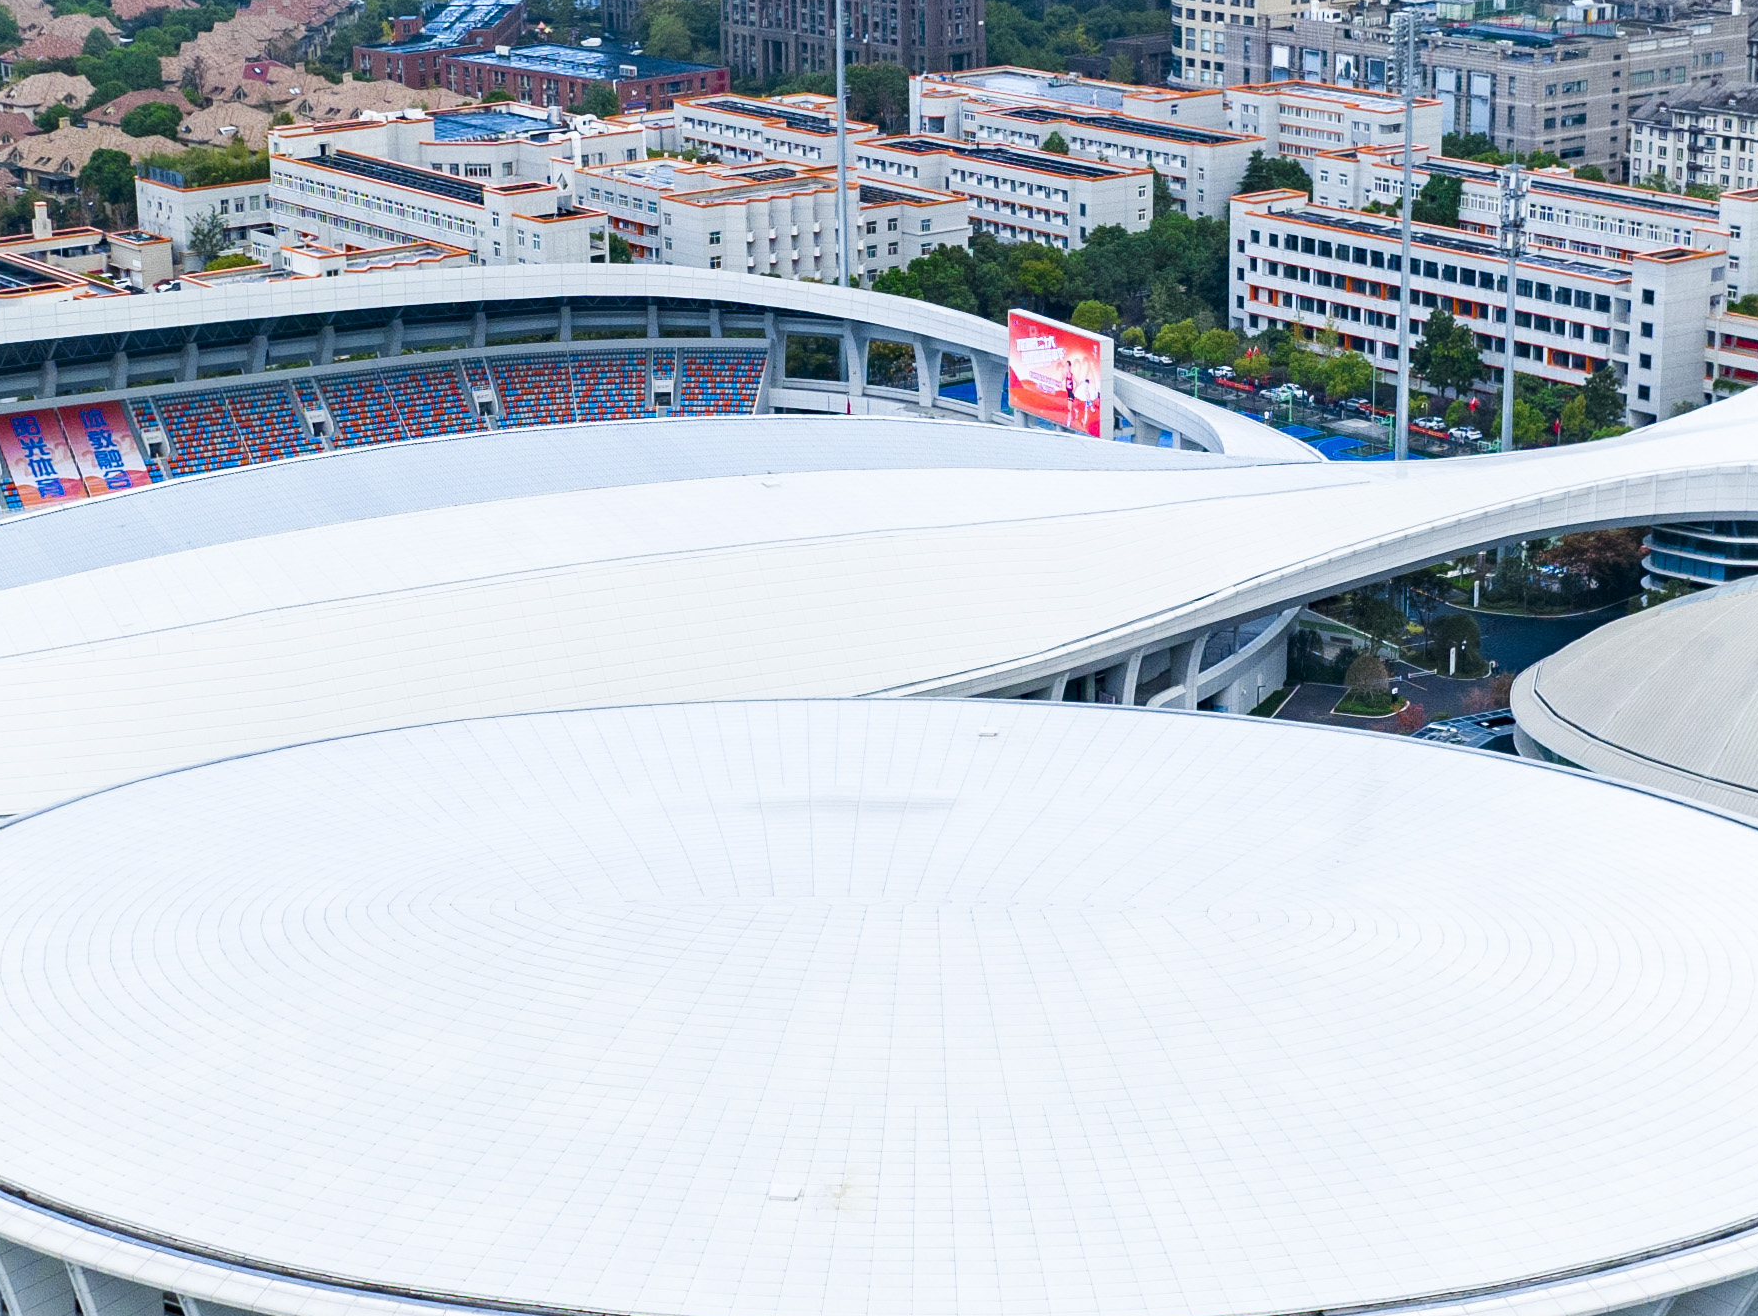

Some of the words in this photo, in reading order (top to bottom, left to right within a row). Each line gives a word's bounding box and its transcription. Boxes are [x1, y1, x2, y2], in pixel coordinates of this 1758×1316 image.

[10, 415, 66, 499] 阳光体育
[79, 408, 134, 491] 体教融合
